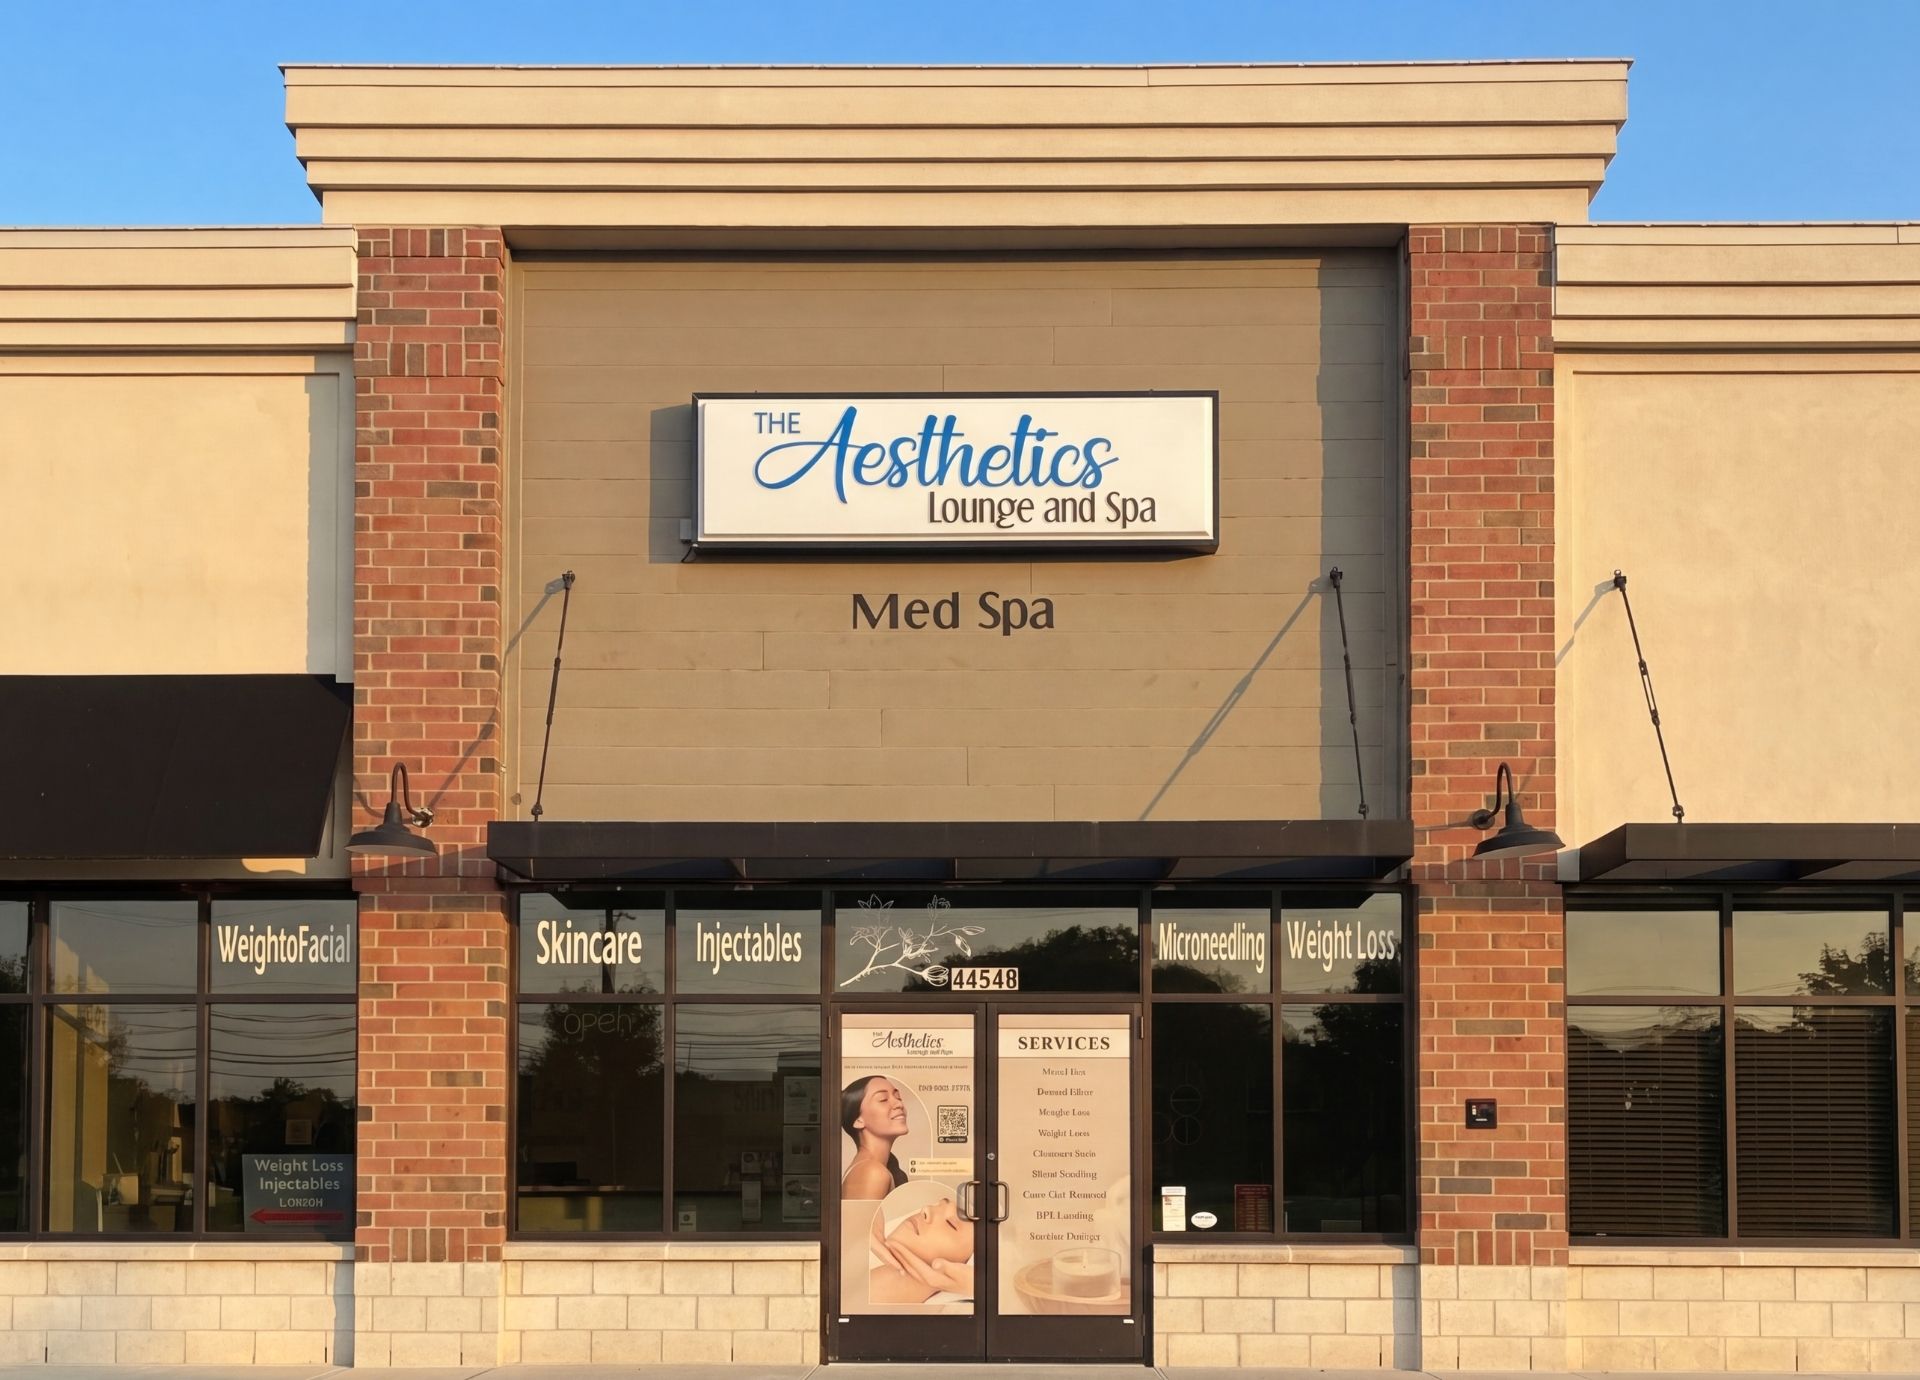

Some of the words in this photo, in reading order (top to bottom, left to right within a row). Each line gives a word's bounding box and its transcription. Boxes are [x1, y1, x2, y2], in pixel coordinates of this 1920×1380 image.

[754, 412, 801, 434] THE
[755, 406, 1119, 504] Aesthetics
[929, 491, 1035, 529] Lounge
[1044, 491, 1096, 524] and
[1106, 491, 1157, 529] Spa
[852, 592, 960, 630] Med
[978, 592, 1055, 637] Spa
[217, 924, 350, 976] WeightoFacial
[536, 920, 642, 965] Skincare
[697, 921, 802, 976] Injectables
[1159, 922, 1265, 974] Microneedling
[1287, 920, 1352, 972] Weight
[1357, 920, 1395, 960] Loss
[952, 968, 1017, 989] 44548
[1018, 1036, 1110, 1050] SERVICES
[254, 1159, 308, 1176] Weight
[312, 1159, 344, 1171] Loss
[260, 1177, 340, 1194] Injectables
